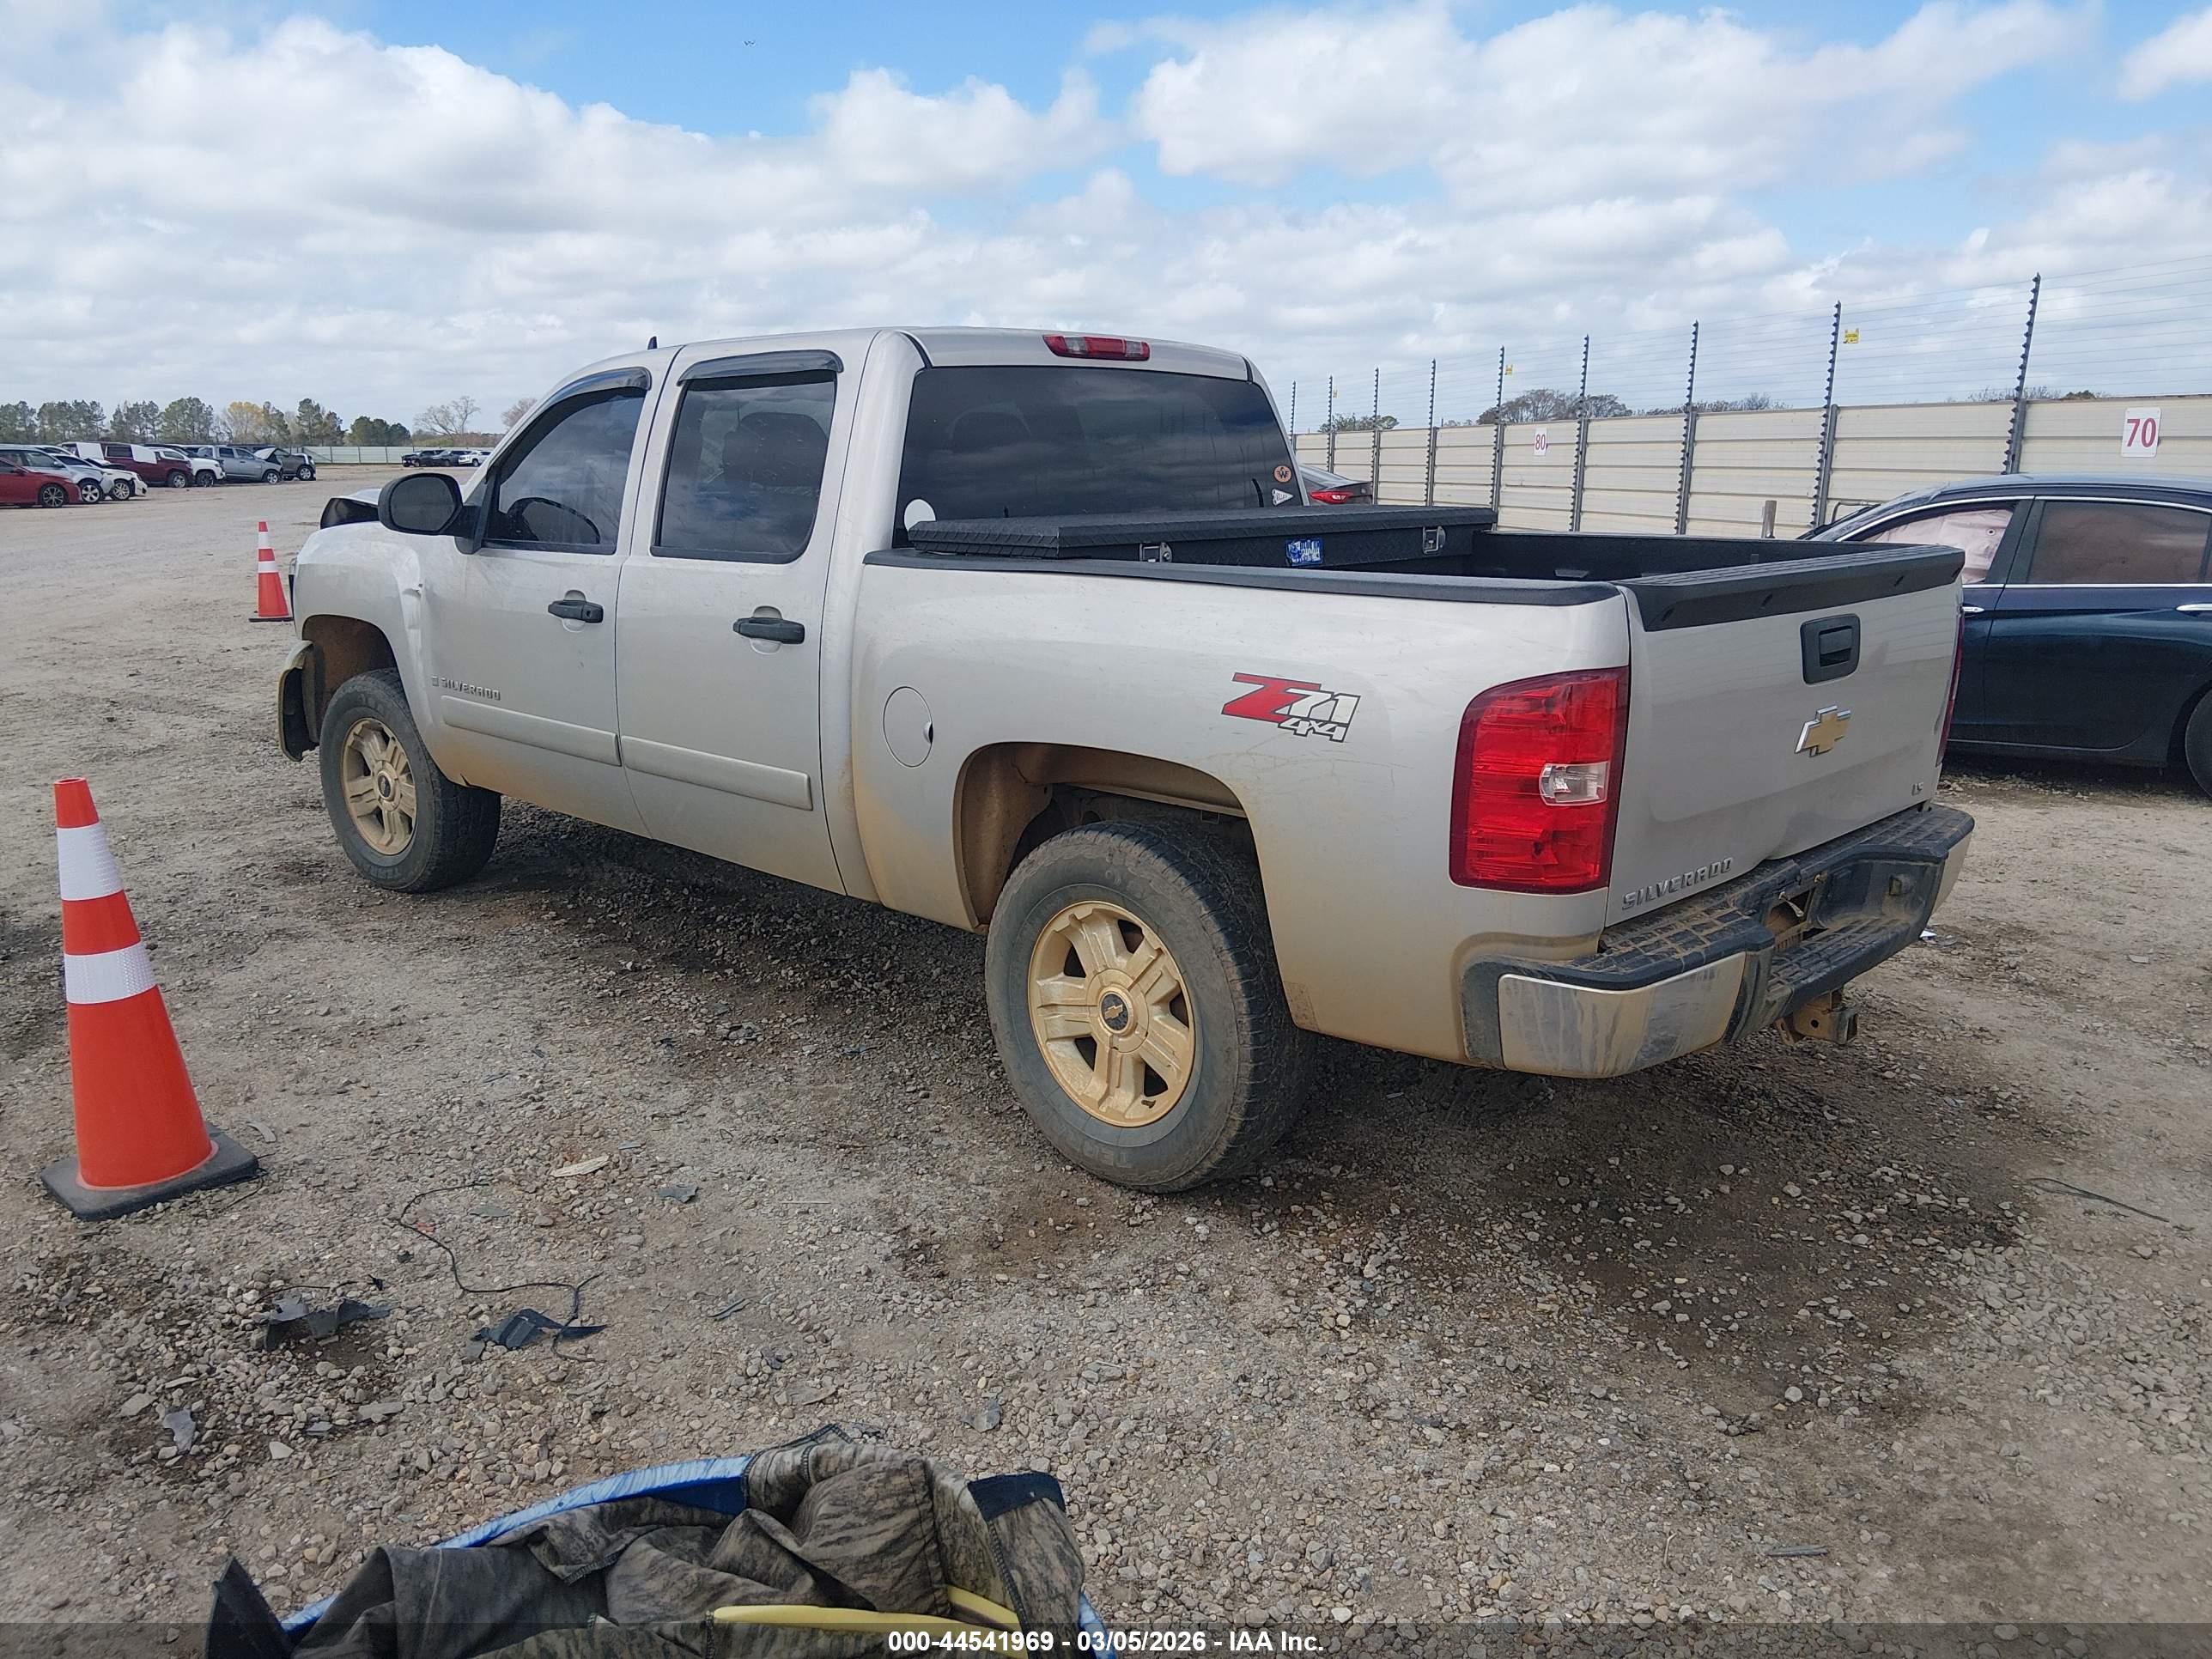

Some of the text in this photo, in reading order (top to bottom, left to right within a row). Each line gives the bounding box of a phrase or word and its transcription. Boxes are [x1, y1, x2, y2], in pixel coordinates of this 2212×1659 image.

[1534, 434, 1547, 451] 80
[2127, 417, 2157, 448] 70
[441, 677, 501, 701] SILVERADO
[1221, 672, 1361, 726] Z71
[1622, 857, 1733, 910] SILVERADO
